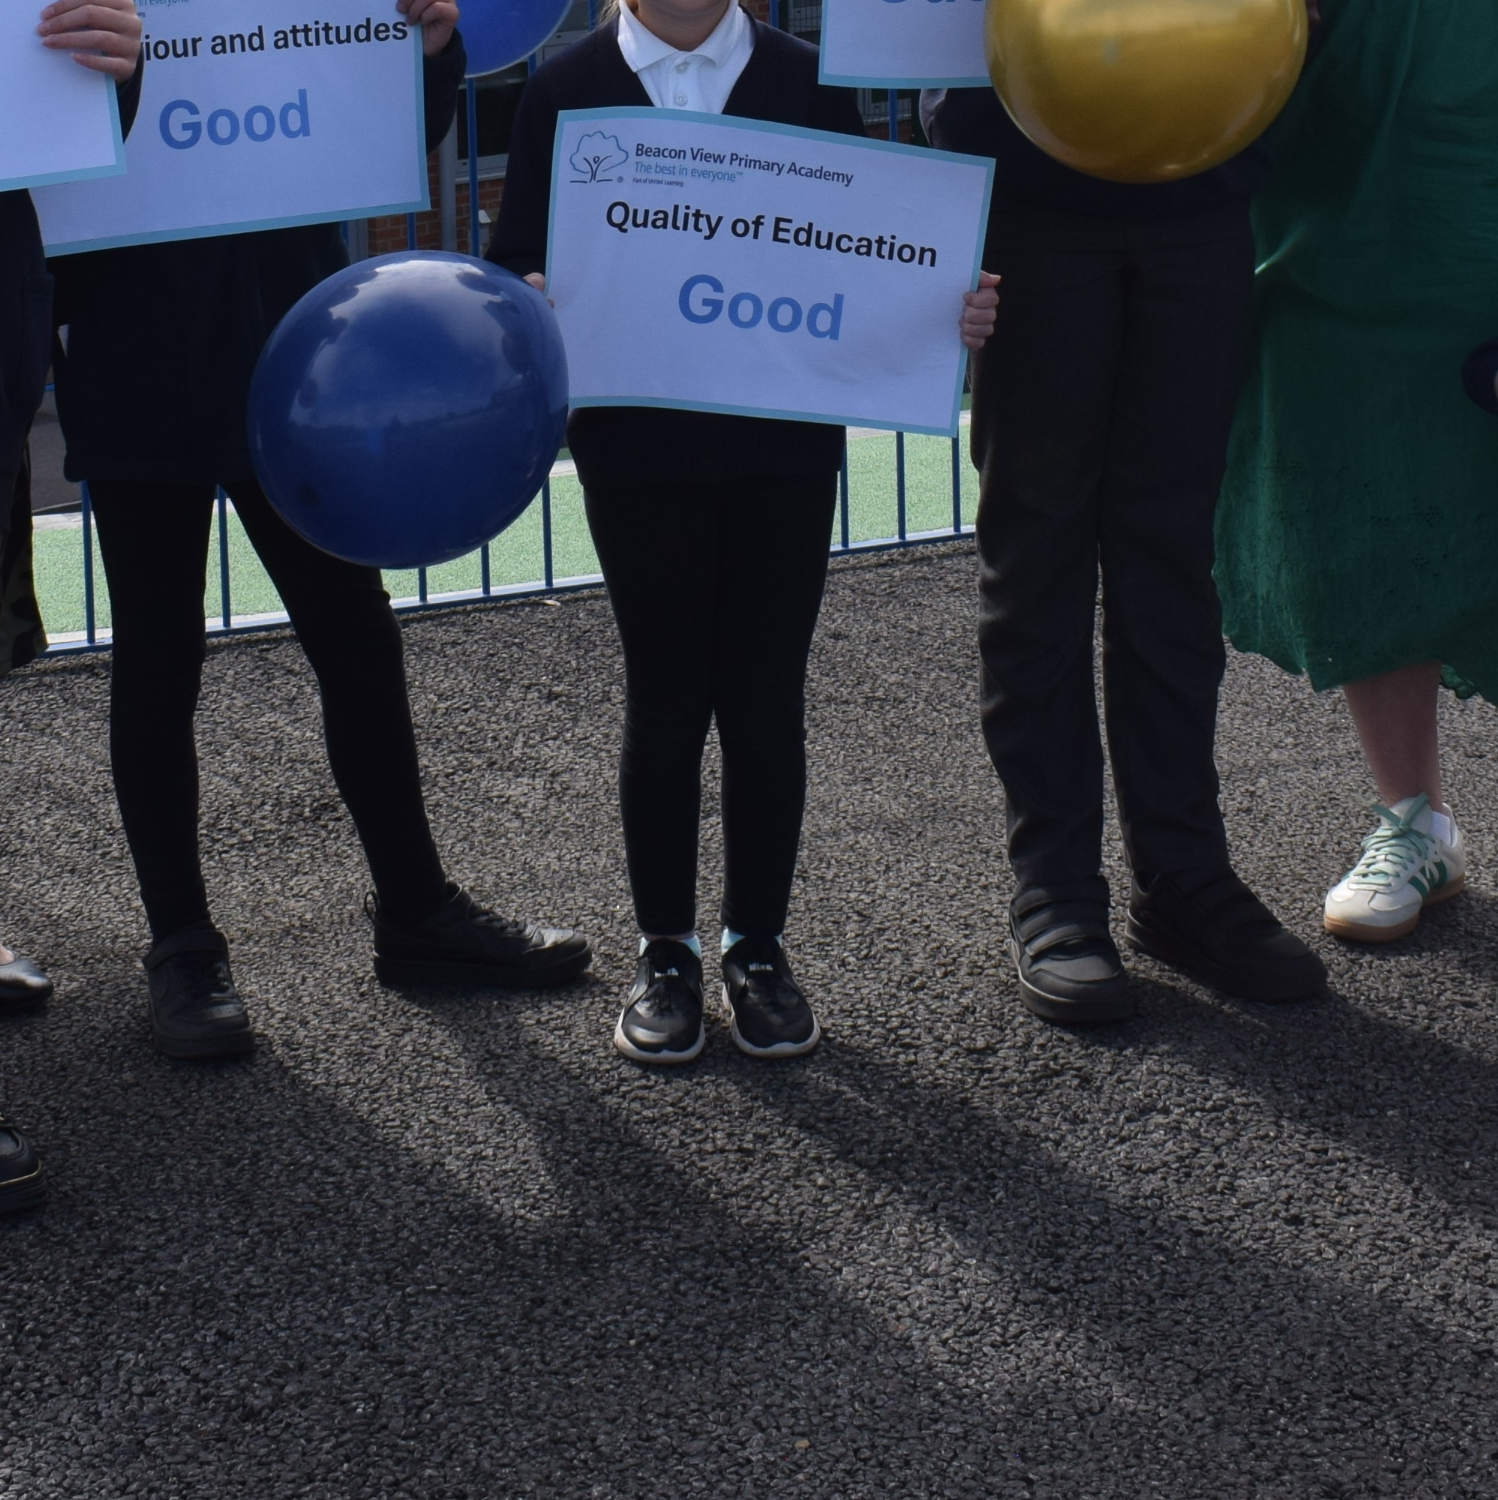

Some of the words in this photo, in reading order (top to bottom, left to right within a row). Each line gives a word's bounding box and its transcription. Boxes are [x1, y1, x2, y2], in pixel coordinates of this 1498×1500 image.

[210, 25, 265, 56] and
[273, 17, 409, 51] attitudes
[158, 88, 311, 150] Good
[635, 143, 687, 160] Beacon
[690, 146, 726, 165] View
[729, 152, 785, 176] Primary
[786, 161, 854, 187] Academy
[635, 161, 652, 174] The
[654, 163, 676, 176] best
[679, 164, 688, 177] in
[605, 200, 724, 241] Quality
[730, 214, 766, 240] of
[771, 216, 938, 268] Education
[678, 274, 845, 341] Good
